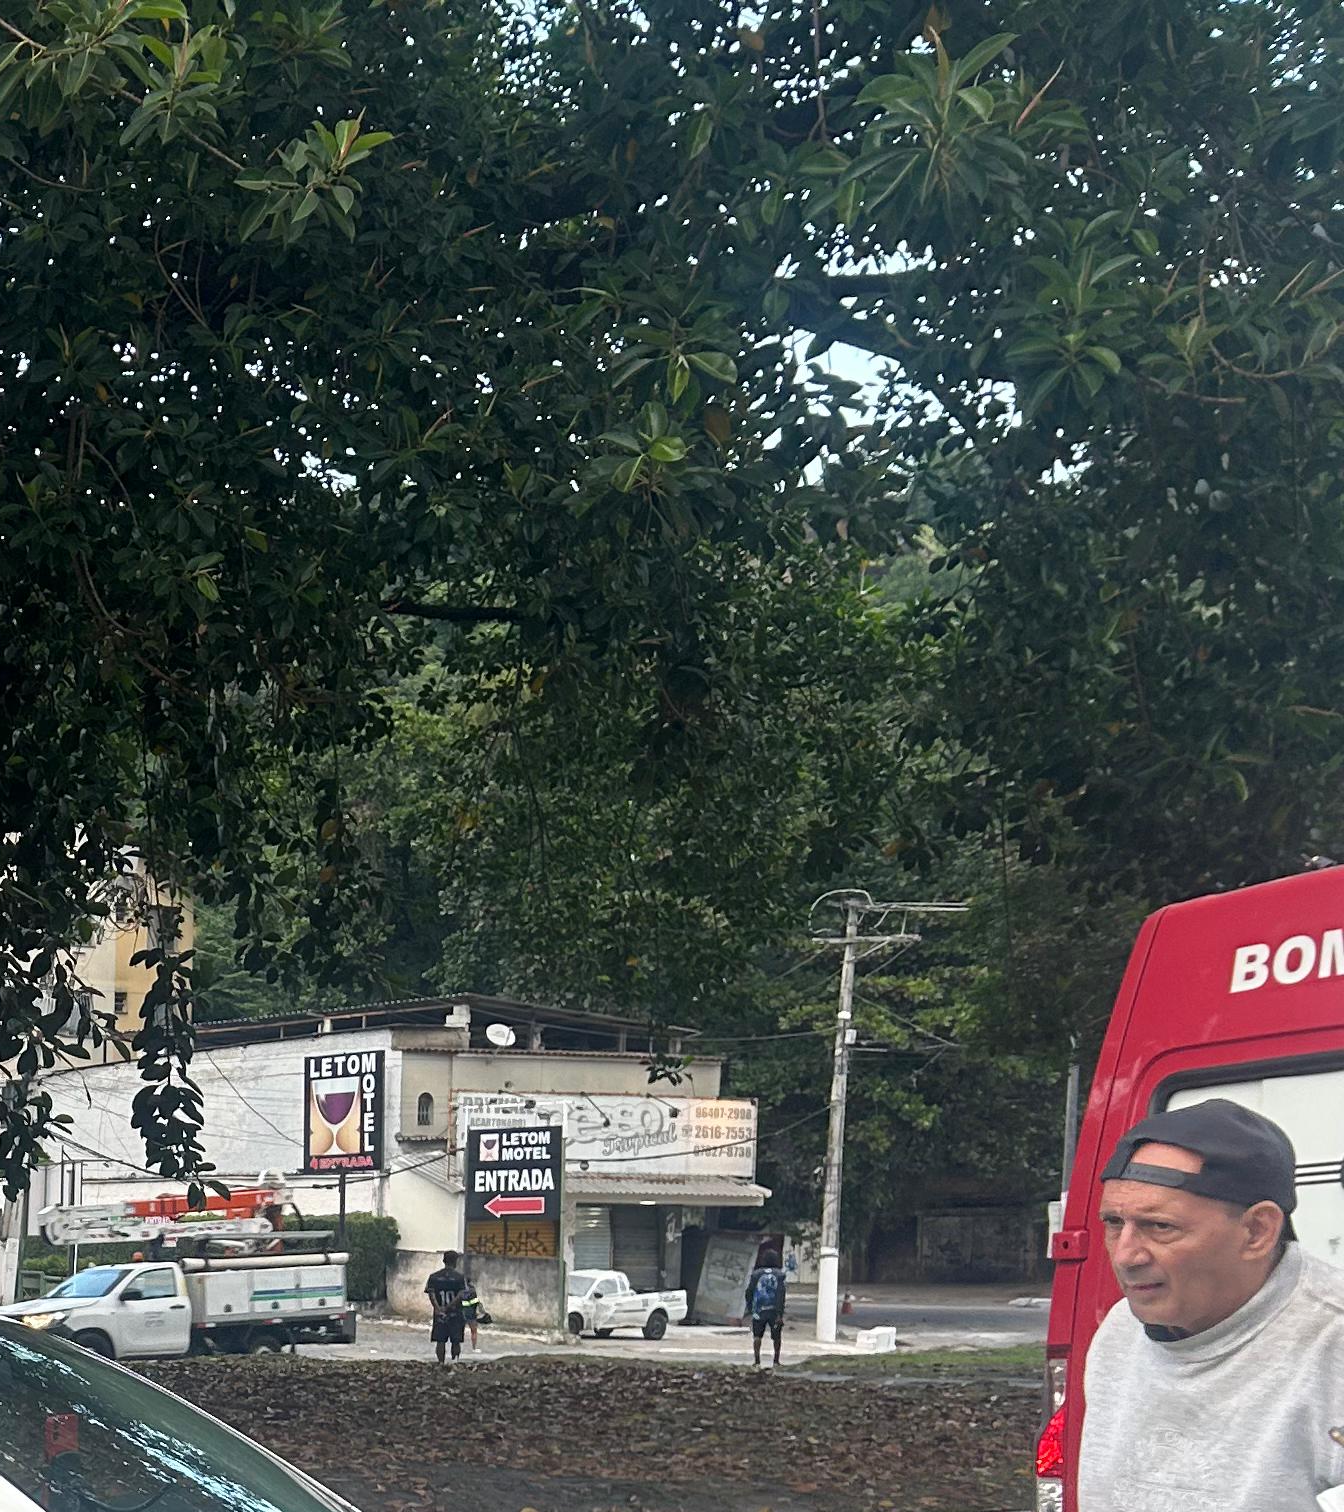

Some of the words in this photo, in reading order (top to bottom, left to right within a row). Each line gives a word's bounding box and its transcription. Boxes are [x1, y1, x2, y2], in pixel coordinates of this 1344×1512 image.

[310, 1053, 376, 1078] LETOM
[502, 1131, 551, 1146] LETOM
[694, 1124, 752, 1140] 2616-7553
[502, 1147, 551, 1161] MOTEL
[474, 1168, 555, 1193] ENTRADA
